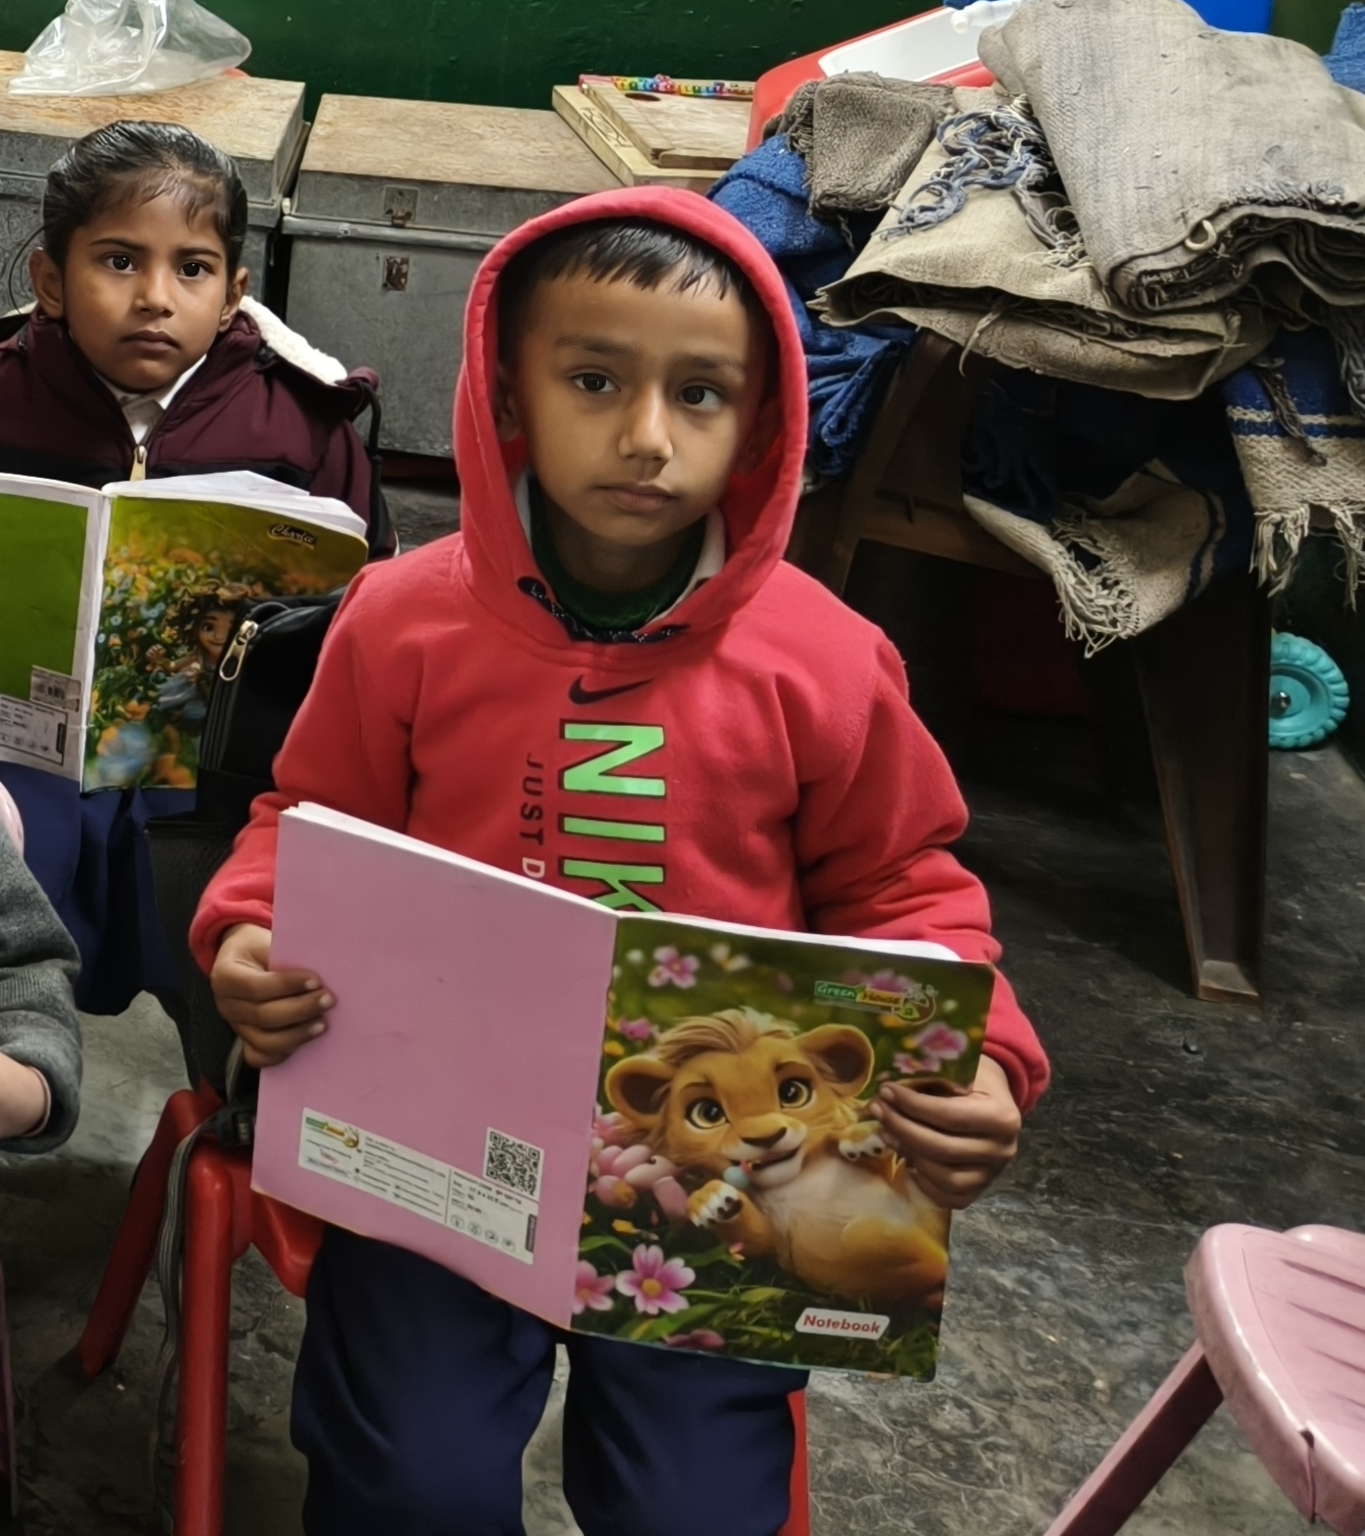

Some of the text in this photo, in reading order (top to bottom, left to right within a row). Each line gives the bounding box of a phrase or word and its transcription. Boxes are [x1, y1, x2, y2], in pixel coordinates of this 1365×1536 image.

[520, 752, 545, 879] JUST D
[559, 718, 667, 913] NIK
[817, 984, 856, 998] Green
[803, 1314, 881, 1334] Notebook
